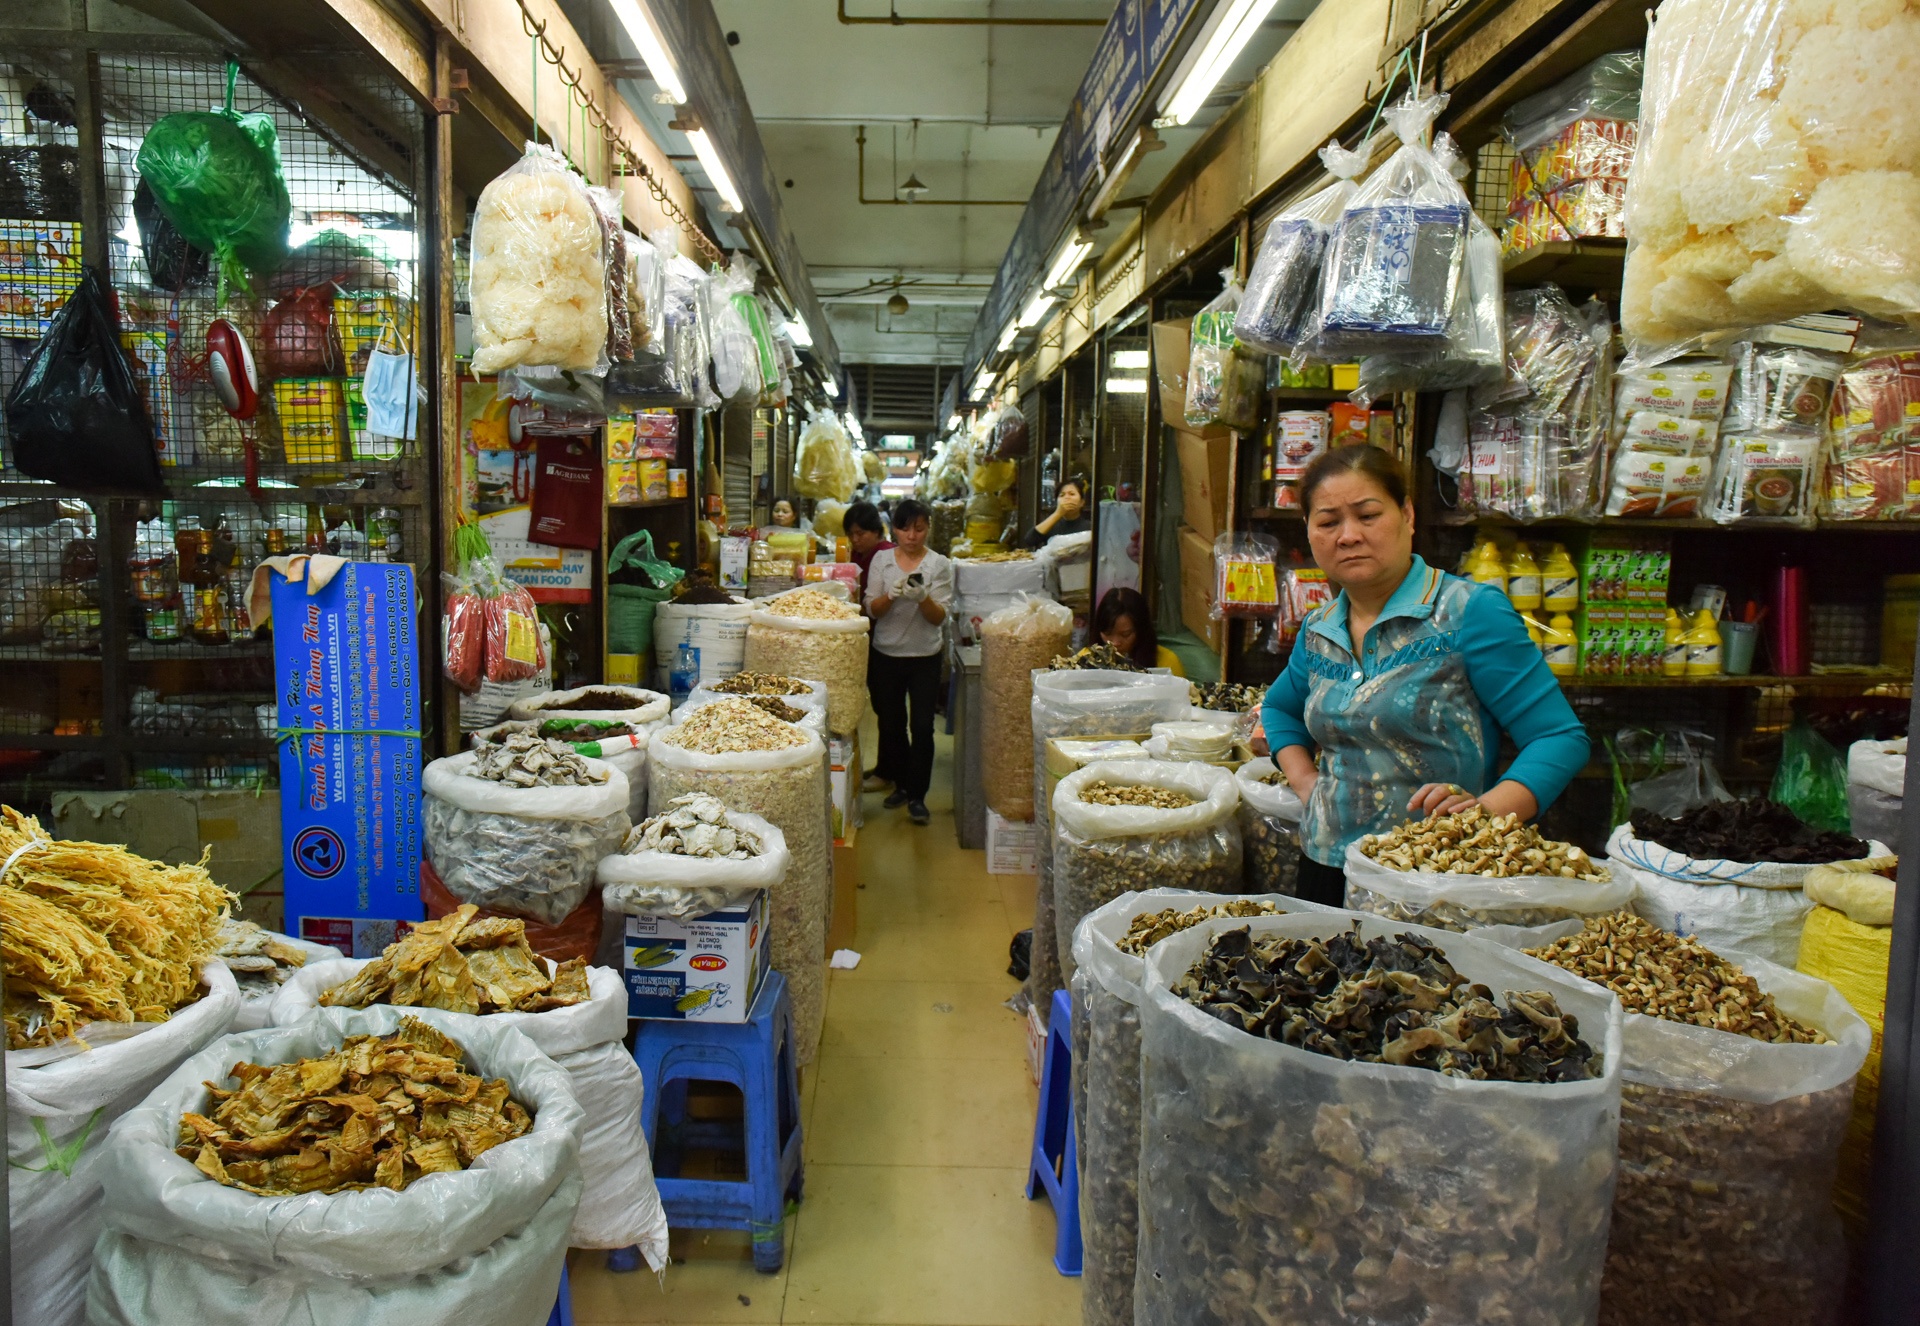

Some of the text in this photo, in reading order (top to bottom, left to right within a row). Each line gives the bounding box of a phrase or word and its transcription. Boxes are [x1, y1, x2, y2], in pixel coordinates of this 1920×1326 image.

[554, 469, 591, 480] AGRIBANK
[541, 576, 572, 585] FOOD
[301, 603, 322, 645] Huy
[398, 570, 410, 645] 0908.688628
[304, 648, 325, 698] Hàng
[533, 678, 543, 687] 25
[308, 703, 324, 717] &
[327, 613, 343, 802] Website: www.dautien.vn
[308, 763, 328, 812] Trình
